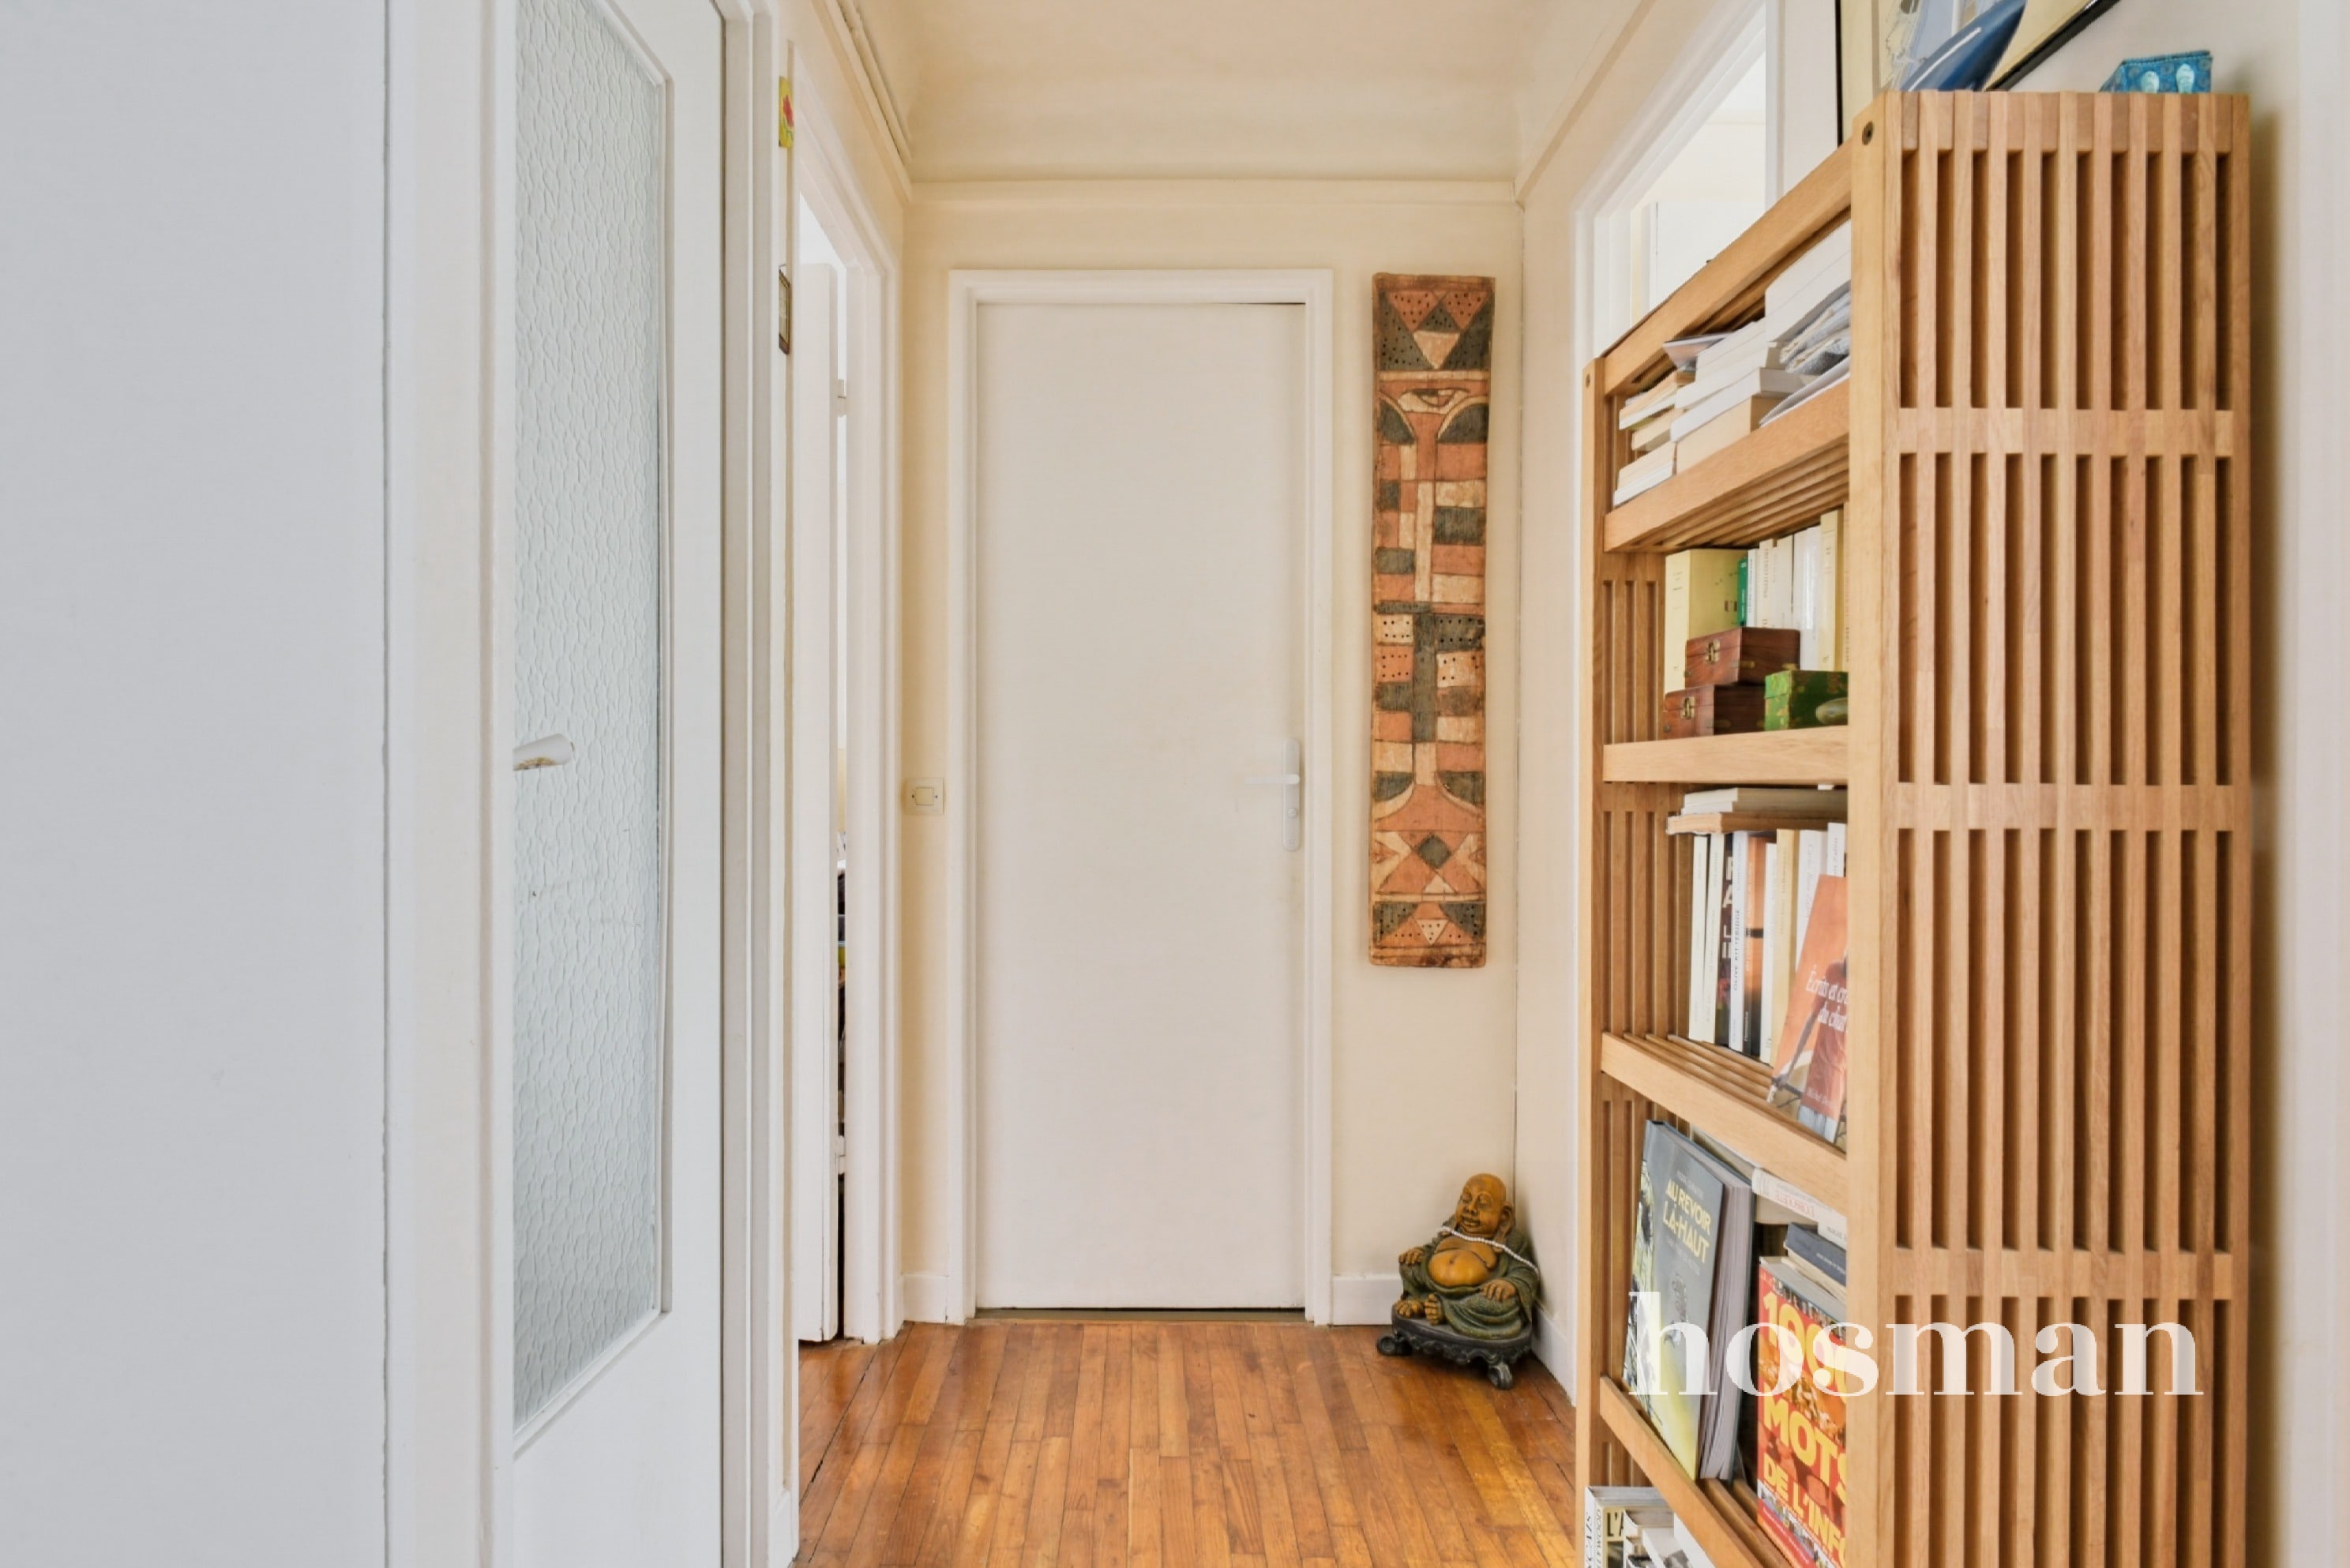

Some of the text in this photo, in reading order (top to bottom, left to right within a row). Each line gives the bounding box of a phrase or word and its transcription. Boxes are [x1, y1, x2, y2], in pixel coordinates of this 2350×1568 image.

[1665, 1179, 1680, 1202] AU
[1678, 1187, 1712, 1236] REVOIR
[1763, 1452, 1789, 1502] DE
